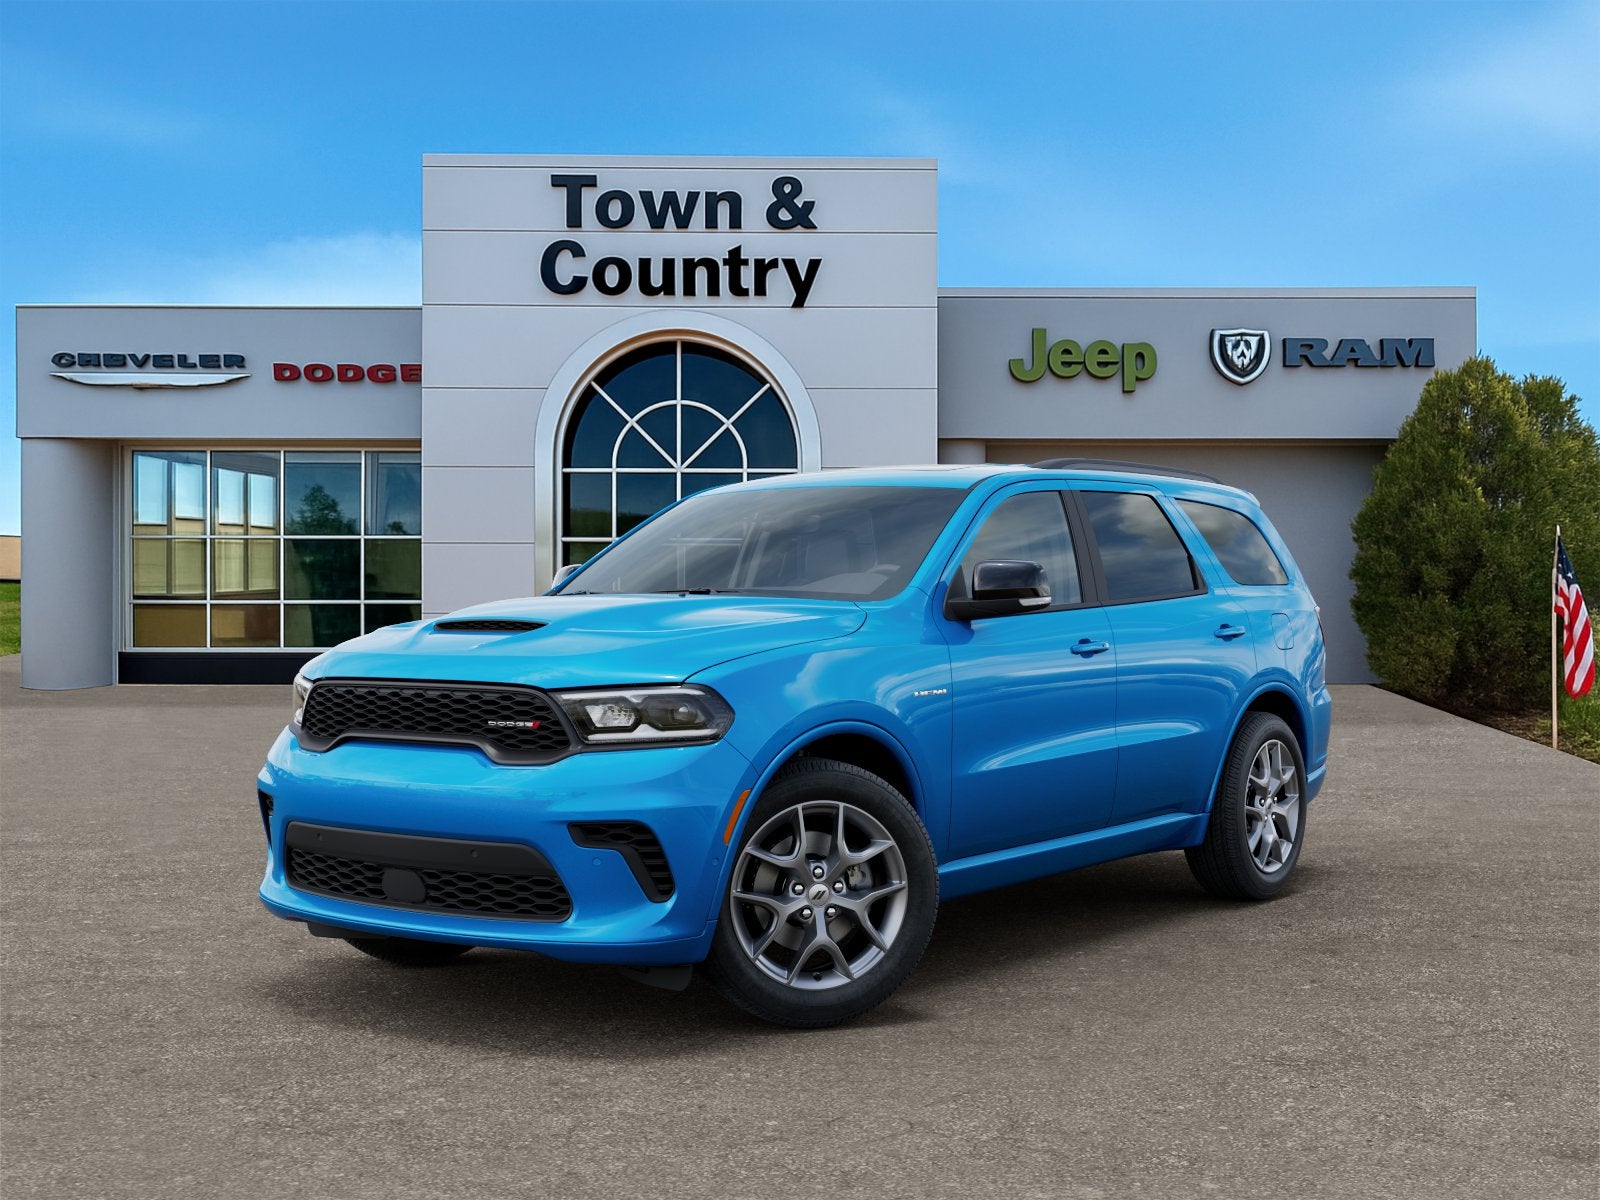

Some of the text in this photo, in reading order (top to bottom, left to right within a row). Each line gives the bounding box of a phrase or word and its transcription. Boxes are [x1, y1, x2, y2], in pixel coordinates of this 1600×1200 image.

[550, 174, 818, 230] Town &
[540, 239, 822, 308] Country
[273, 363, 422, 383] DODGE
[1009, 328, 1158, 393] Jeep
[1282, 337, 1436, 368] RAM
